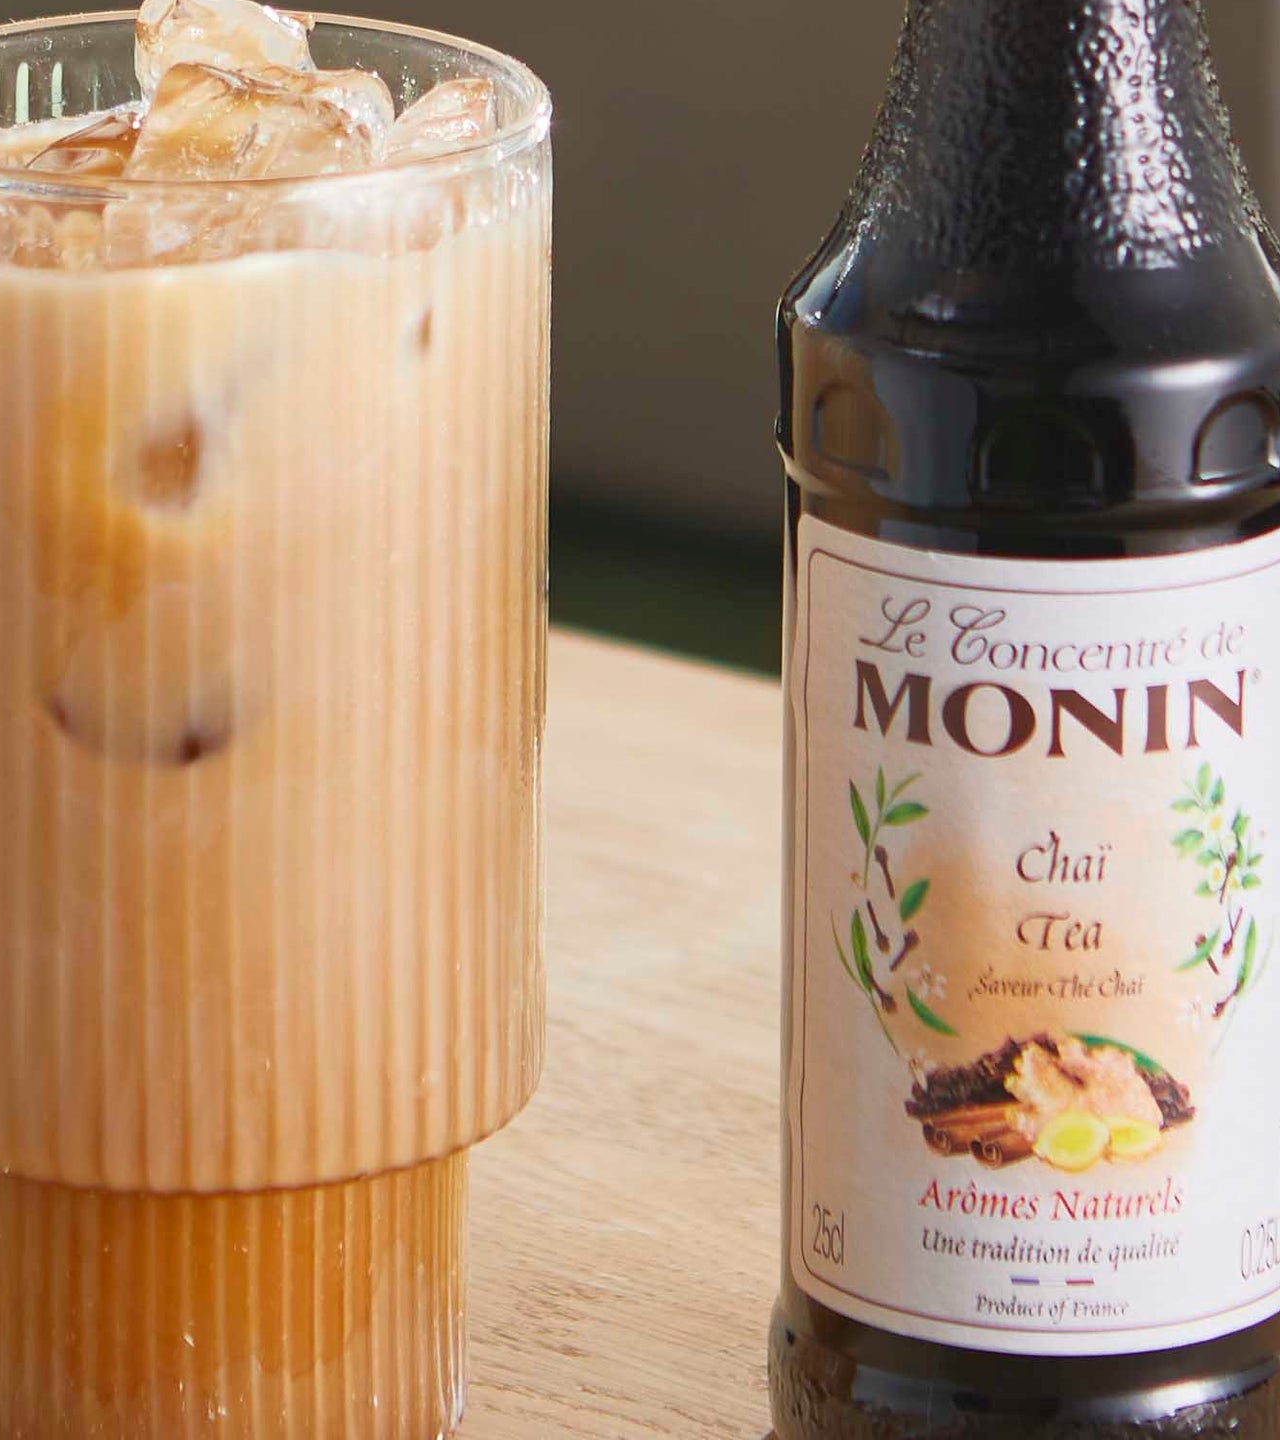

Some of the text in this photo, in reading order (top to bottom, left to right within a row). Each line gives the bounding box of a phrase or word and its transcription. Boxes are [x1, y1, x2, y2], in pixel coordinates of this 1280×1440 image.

[860, 597, 1246, 672] Le Concentré de
[853, 658, 1247, 758] MONIN
[1016, 831, 1113, 884] Chaï
[1016, 911, 1102, 952] Tea
[968, 965, 1042, 1001] Saveur
[918, 1177, 1184, 1221] Arômes Naturels
[922, 1228, 965, 1257] Une
[971, 1235, 1070, 1265] tradition
[1077, 1236, 1101, 1265] de
[976, 1293, 1129, 1325] Product of France
